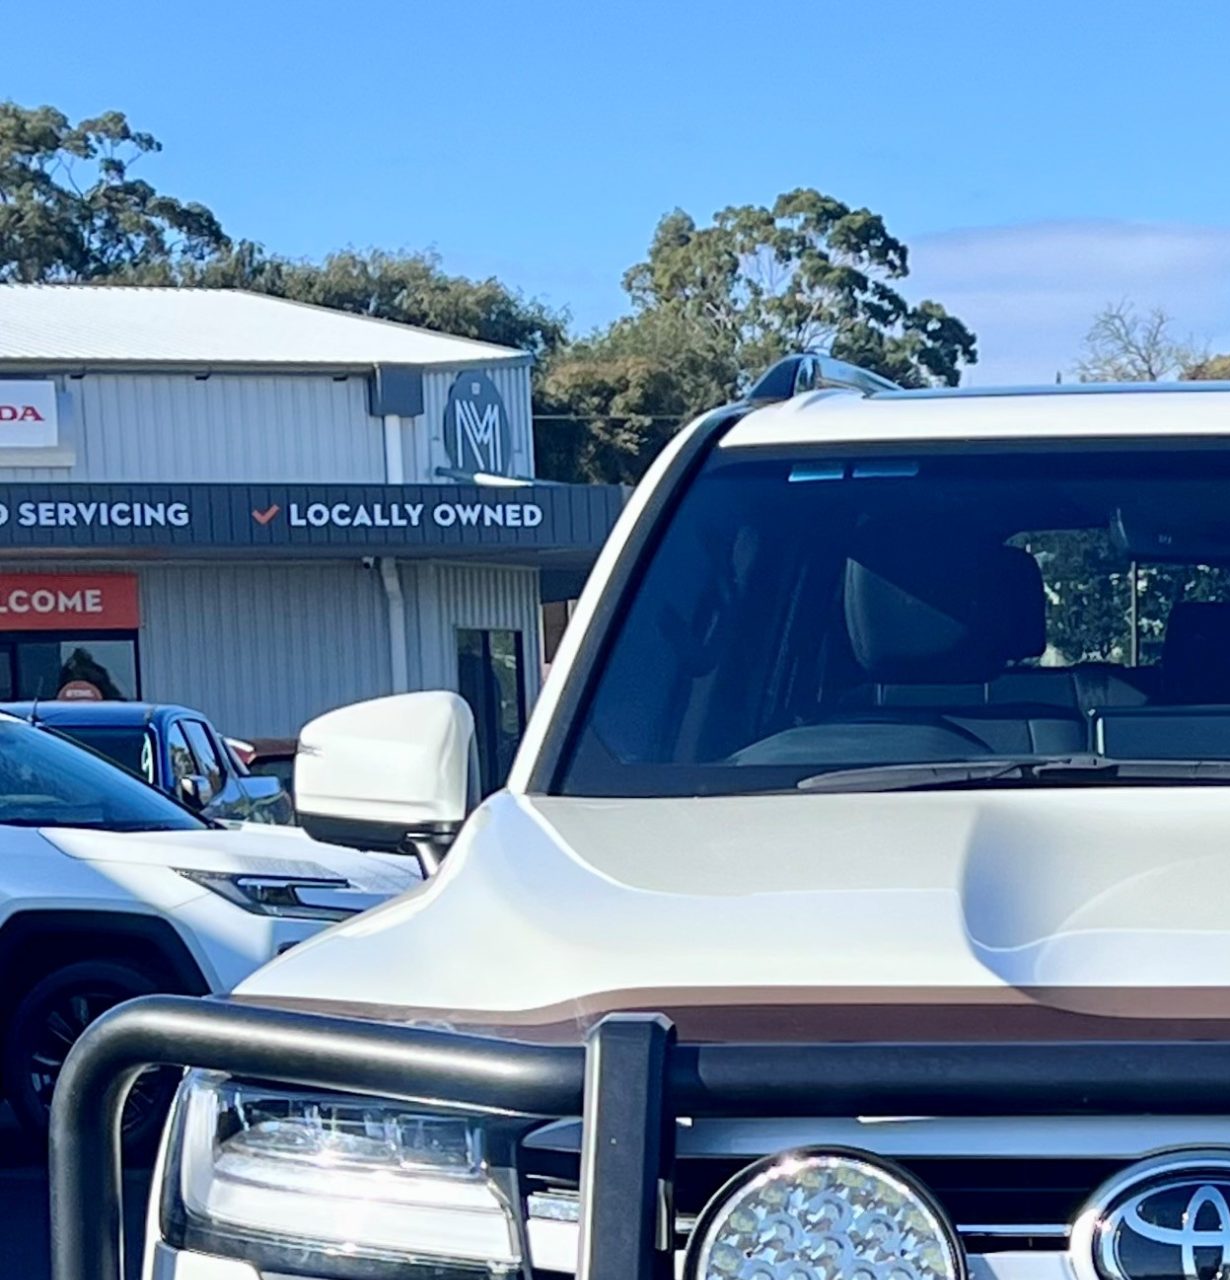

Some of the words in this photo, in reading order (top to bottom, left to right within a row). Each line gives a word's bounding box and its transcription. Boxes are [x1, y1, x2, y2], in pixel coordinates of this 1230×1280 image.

[18, 502, 190, 527] SERVICING
[290, 503, 424, 527] LOCALLY
[433, 503, 543, 527] OWNED
